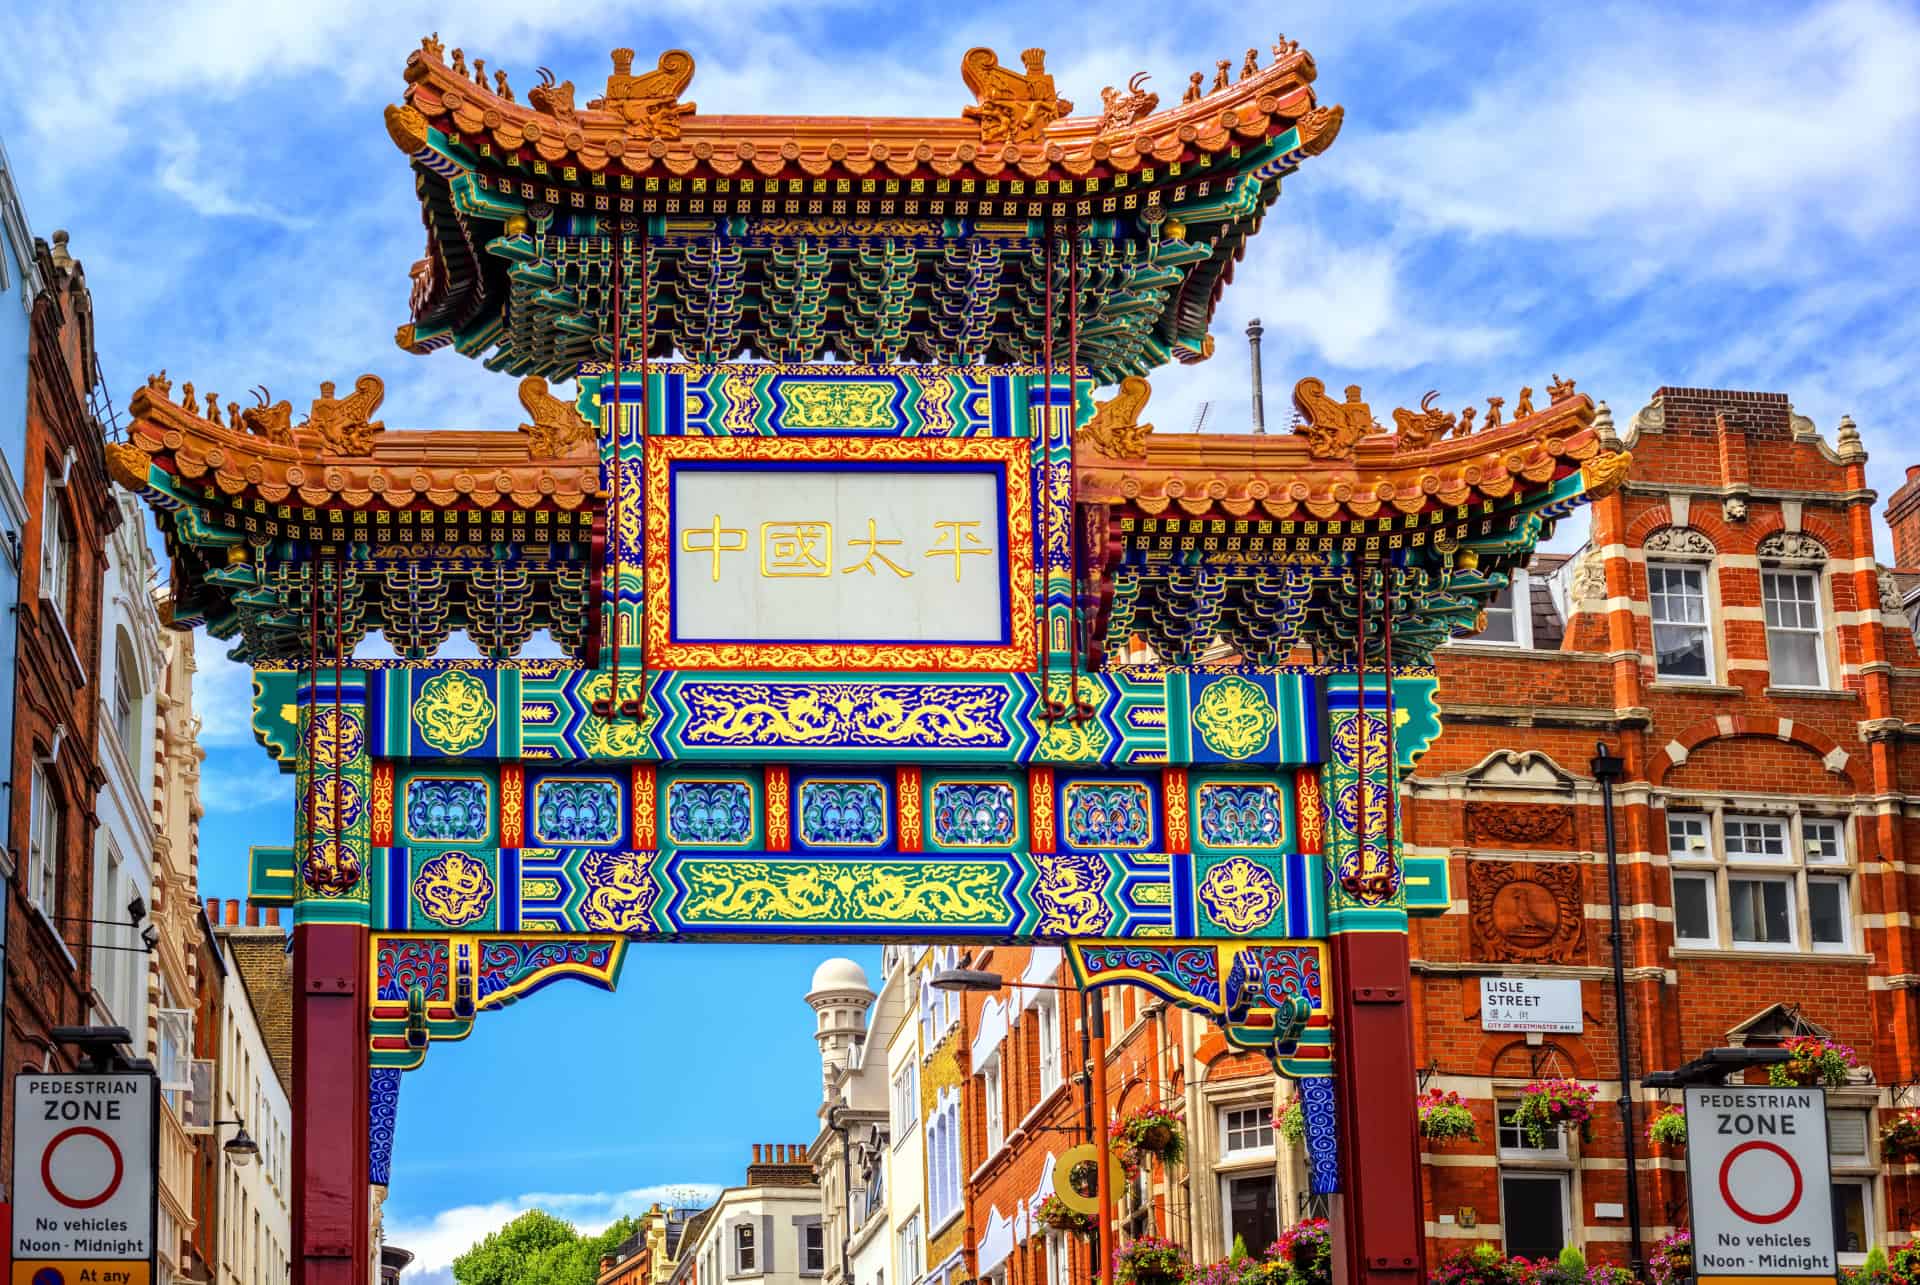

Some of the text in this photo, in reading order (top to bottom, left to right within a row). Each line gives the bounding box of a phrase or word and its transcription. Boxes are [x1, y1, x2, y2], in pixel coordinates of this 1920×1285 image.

[682, 514, 993, 583] 中國太平
[1487, 982, 1524, 993] LISLE
[1488, 995, 1541, 1007] STREET
[29, 1081, 137, 1095] PEDESTRIAN
[1700, 1095, 1811, 1108] PEDESTRIAN
[44, 1100, 121, 1121] ZONE
[1717, 1114, 1796, 1135] ZONE
[36, 1218, 128, 1232] No vehicles
[19, 1239, 61, 1252] Noon
[74, 1239, 144, 1255] Midnight
[1718, 1233, 1811, 1247] No vehicles
[1703, 1254, 1745, 1268] Noon
[1759, 1255, 1829, 1270] Midnight
[80, 1269, 131, 1284] At any
